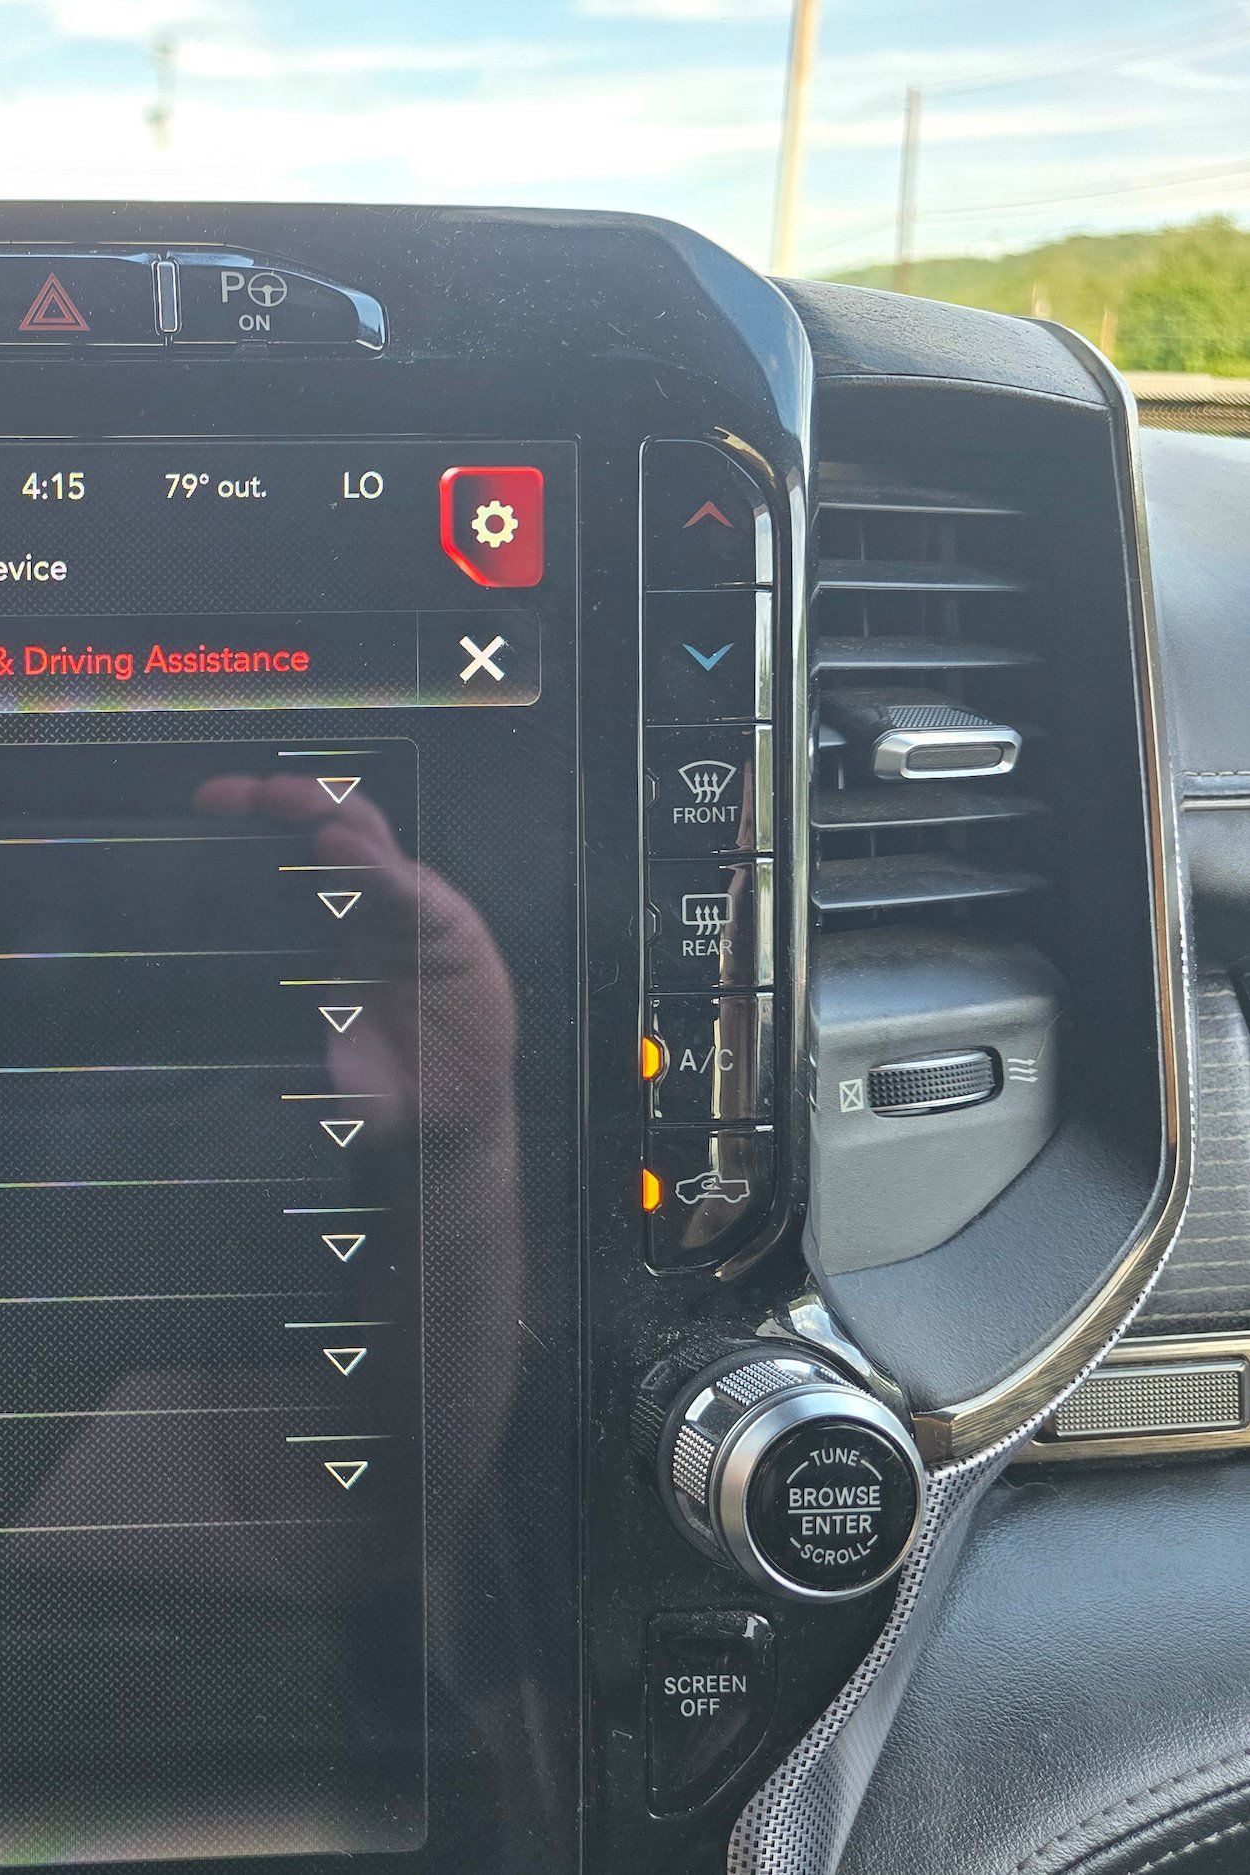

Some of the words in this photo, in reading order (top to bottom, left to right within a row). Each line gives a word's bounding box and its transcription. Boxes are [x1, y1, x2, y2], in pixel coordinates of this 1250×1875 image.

[238, 314, 271, 331] ON
[22, 471, 85, 500] 4:15
[165, 473, 210, 499] 79°
[217, 476, 267, 498] out.
[343, 470, 384, 500] LO
[24, 646, 134, 681] Driving
[143, 644, 310, 674] Assistance
[673, 805, 738, 824] FRONT
[680, 939, 734, 958] REAR
[678, 1046, 735, 1073] A/C
[809, 1447, 860, 1467] TUNE
[788, 1484, 882, 1509] BROWSE
[801, 1514, 872, 1536] ENTER
[800, 1543, 870, 1565] SCROLL
[664, 1674, 747, 1695] SCREEN
[680, 1697, 720, 1718] OFF
